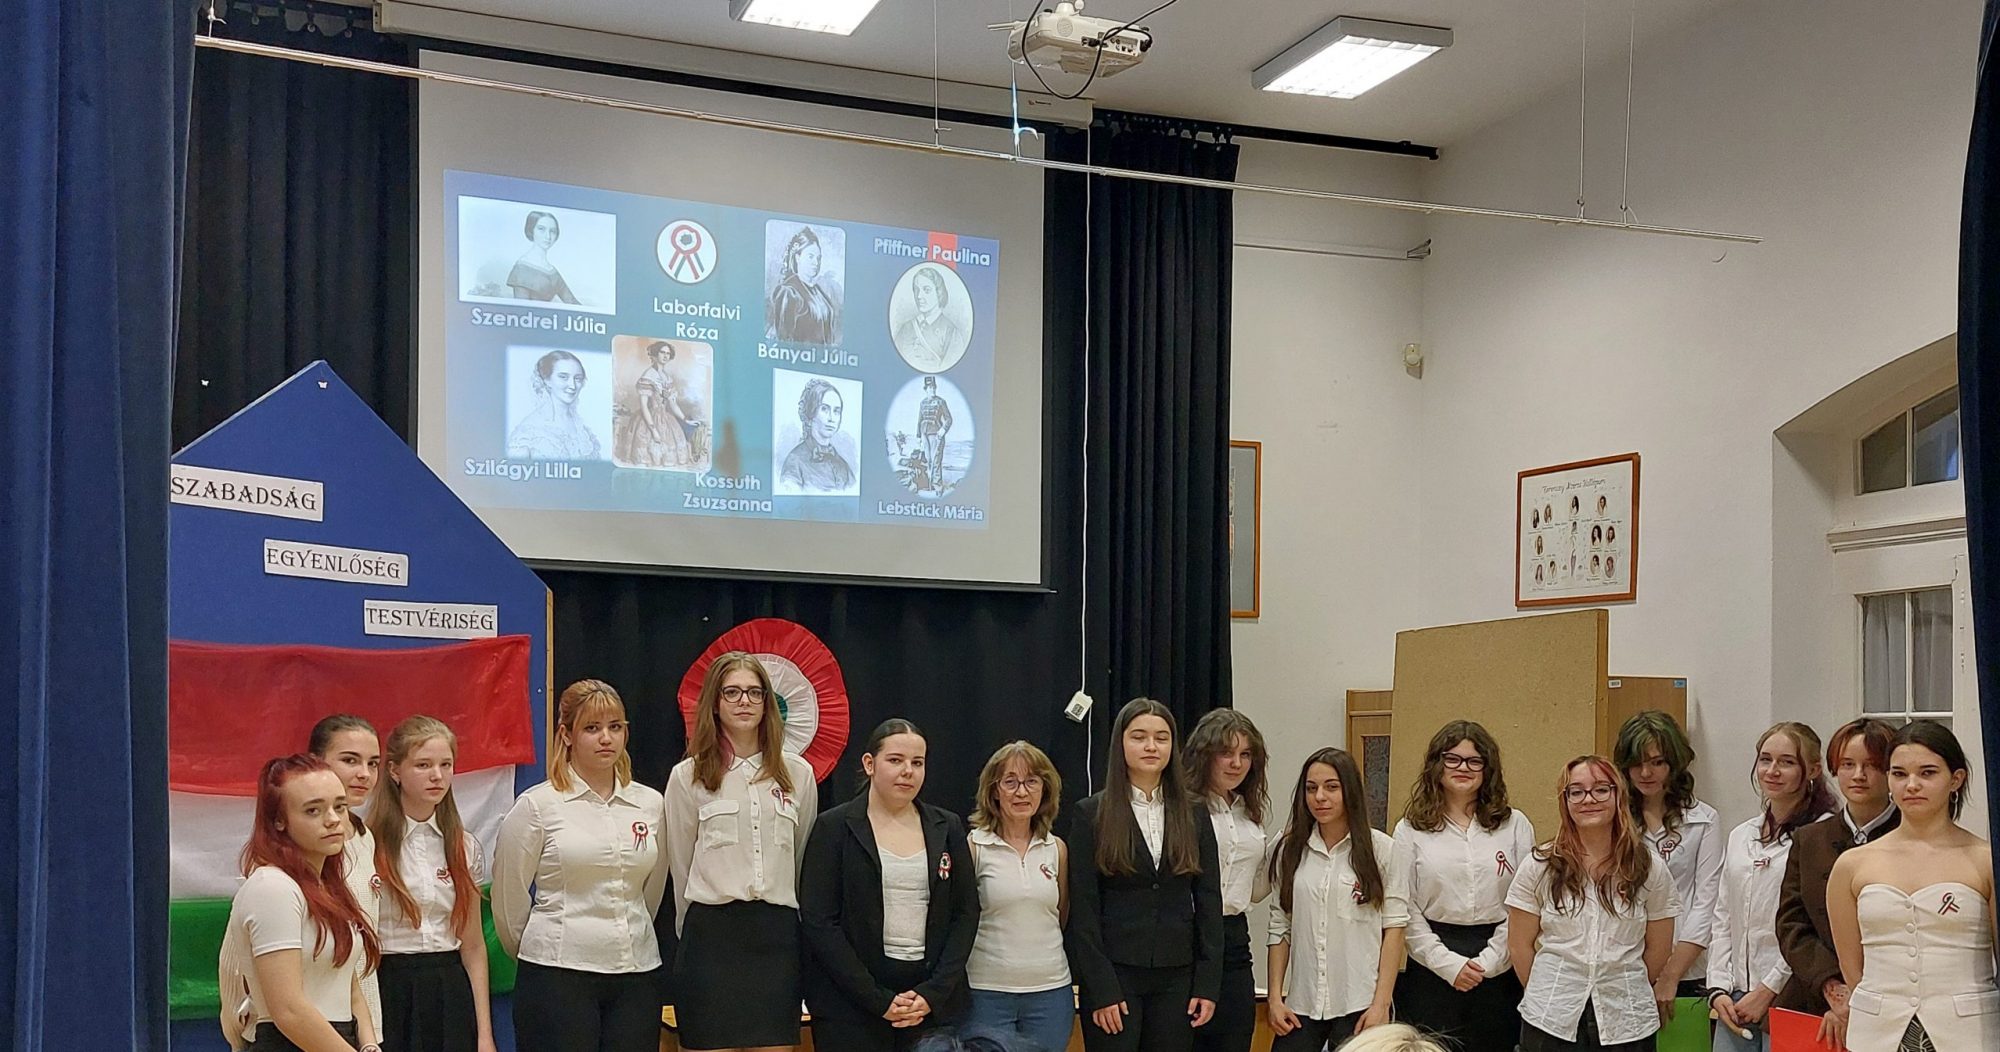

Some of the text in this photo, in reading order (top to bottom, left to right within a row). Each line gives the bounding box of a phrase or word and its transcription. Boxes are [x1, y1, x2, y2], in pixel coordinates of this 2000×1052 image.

[873, 237, 991, 267] Pfiffner Paulina
[471, 307, 607, 335] Szendrei Júlia
[653, 297, 741, 321] Laborfalvi
[676, 321, 719, 340] Róza
[757, 342, 859, 368] Bányai Júlia
[464, 458, 582, 482] Szilágyi Lilla
[695, 472, 761, 491] Kossuth
[170, 476, 317, 512] SZABADSÁG
[682, 492, 773, 513] Zsuzsanna
[878, 500, 984, 521] Lebstück Mária
[266, 547, 401, 580] EGYENLŐSÉG
[365, 606, 495, 631] TESTVÉRISÉG
